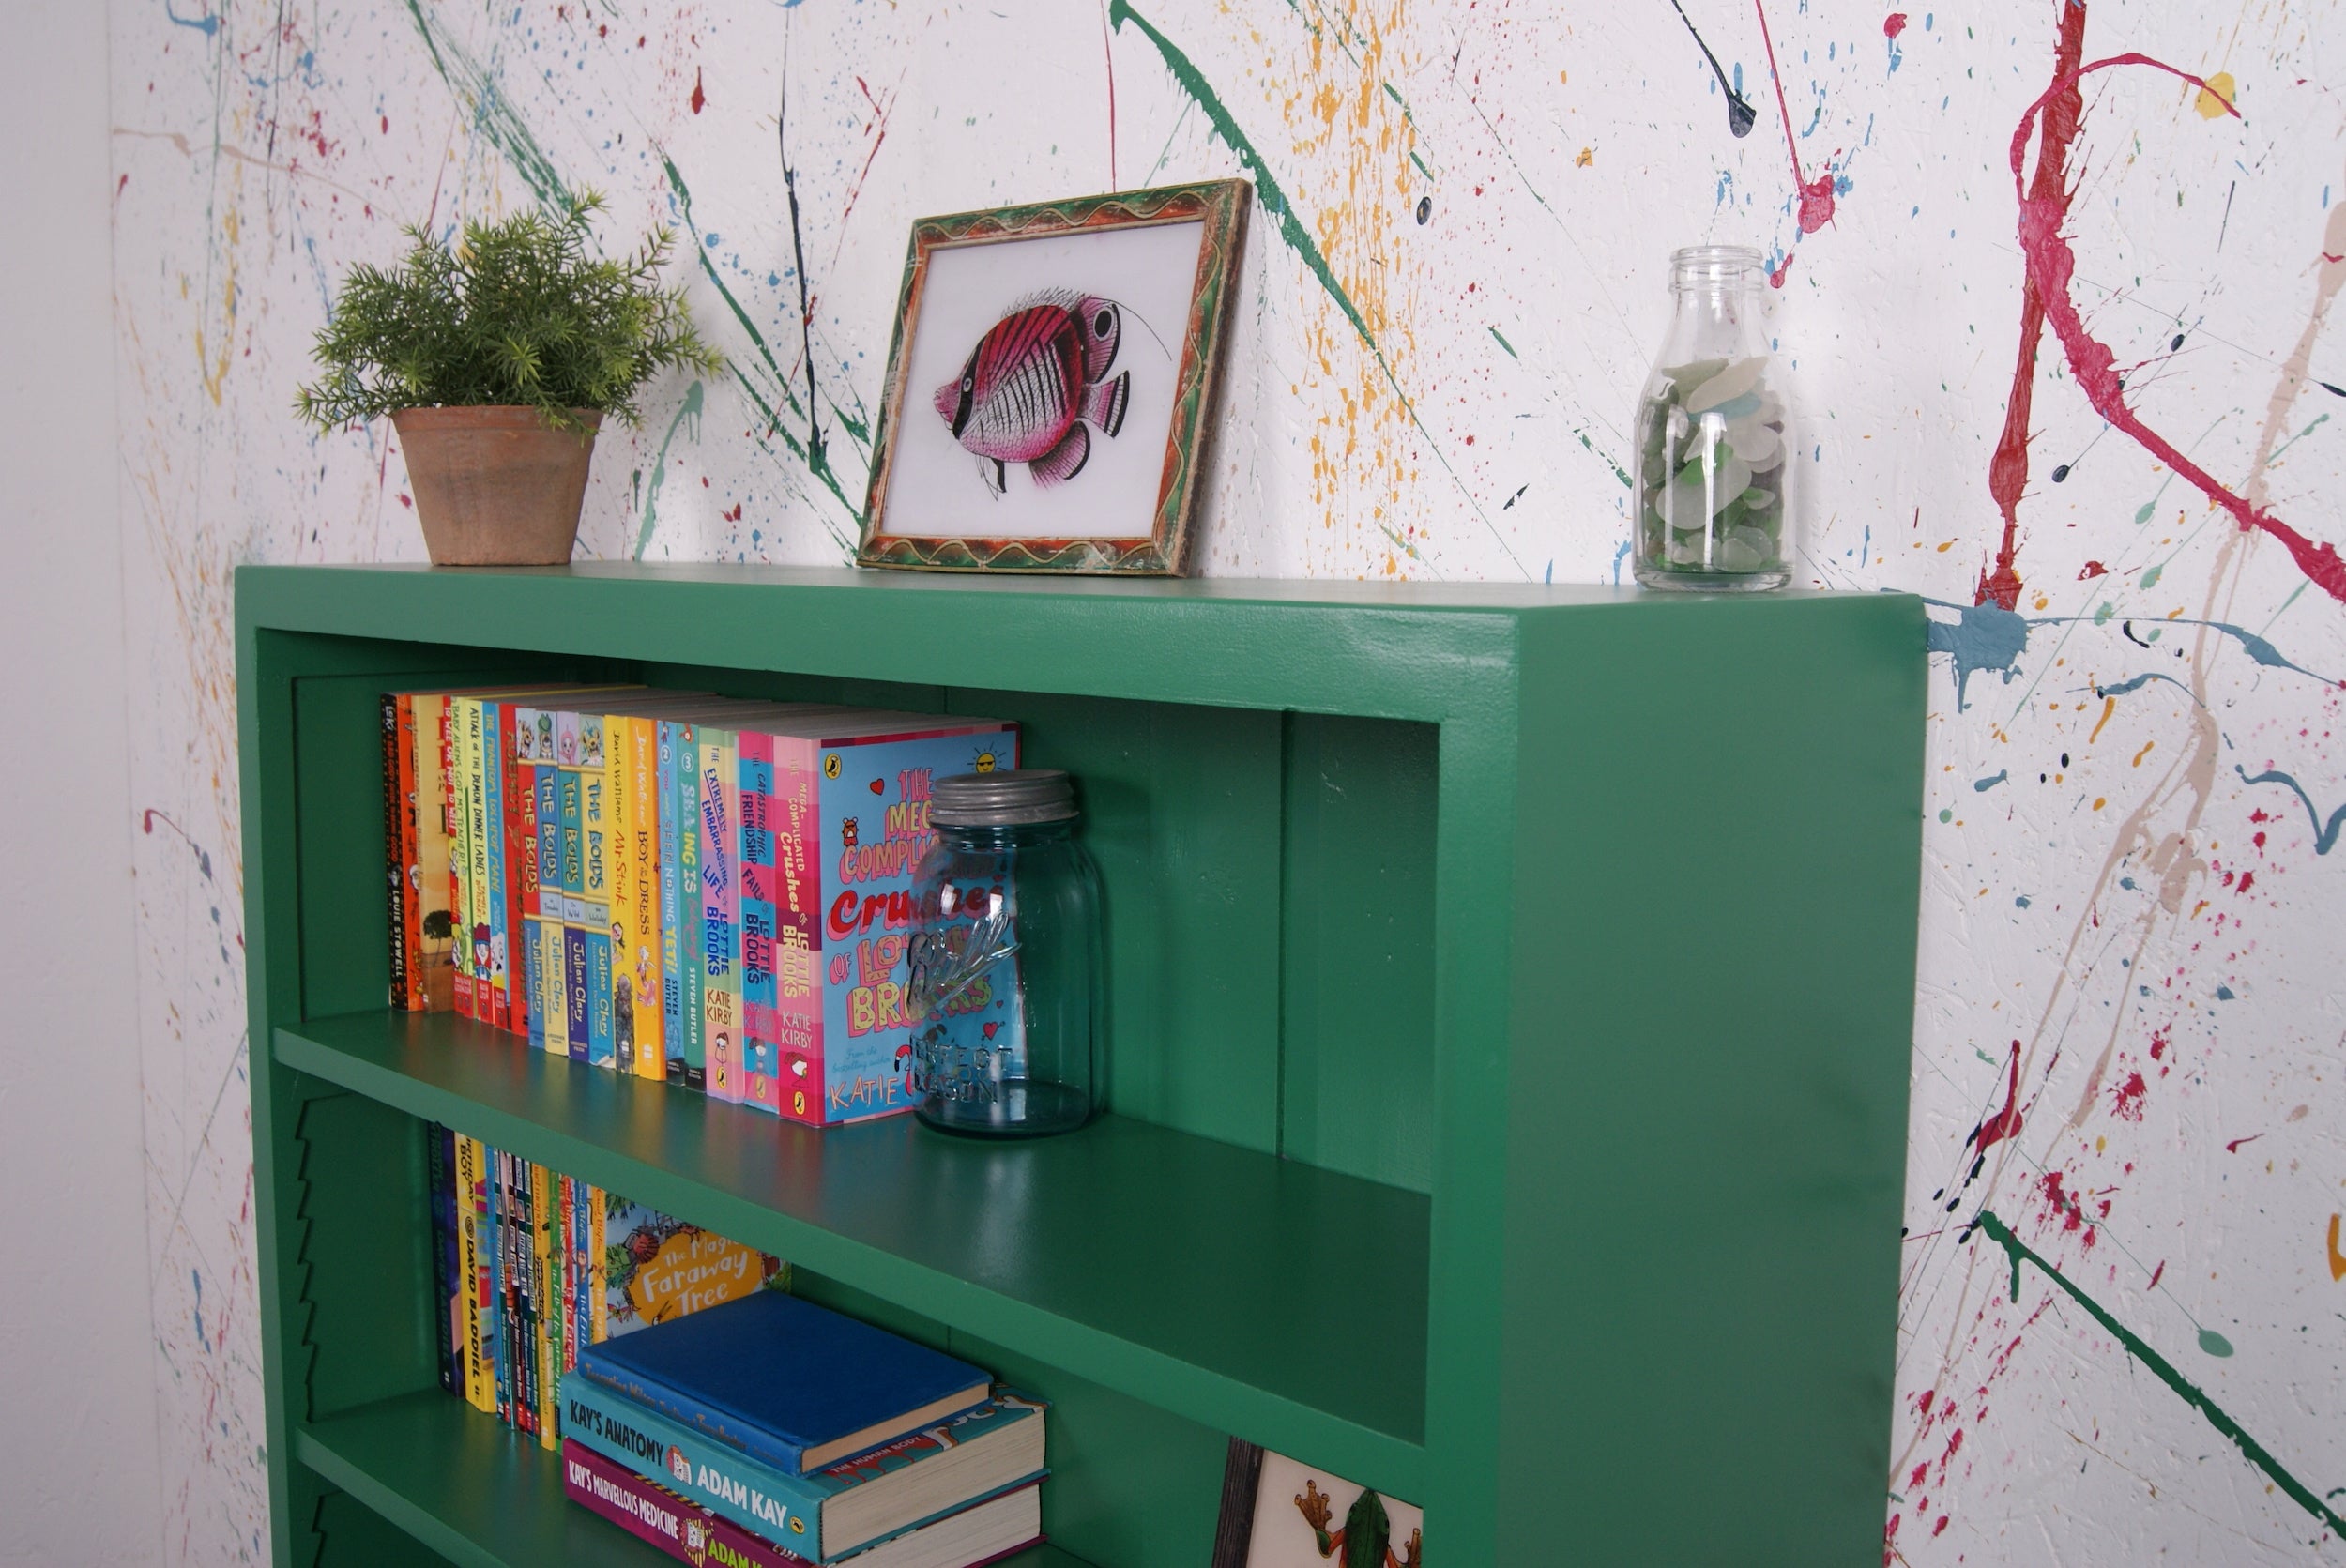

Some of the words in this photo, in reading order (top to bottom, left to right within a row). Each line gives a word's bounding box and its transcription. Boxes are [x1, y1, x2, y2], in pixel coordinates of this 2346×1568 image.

[470, 707, 480, 739] ATTACK
[453, 733, 462, 767] ALIENS
[613, 730, 621, 765] David
[472, 773, 482, 806] DEMON
[541, 773, 555, 814] THE
[563, 777, 576, 818] THE
[587, 778, 602, 823] THE
[707, 768, 727, 832] EXTREMELY
[899, 768, 934, 799] THE
[456, 798, 464, 813] MY
[473, 808, 483, 841] DINNER
[523, 784, 535, 826] THE
[756, 772, 767, 858] CATASTROPHIC
[886, 801, 935, 837] MEG
[615, 829, 625, 859] Mr
[638, 830, 648, 868] BOY
[665, 821, 674, 864] SEEN
[701, 799, 728, 887] EMBARRASSING
[742, 794, 758, 865] FRIENDSHIP
[788, 797, 805, 872] COMPLICATED
[475, 844, 486, 875] LADIES
[524, 834, 538, 893] BOLDS
[541, 821, 557, 879] BOLDS
[564, 827, 579, 884] BOLDS
[588, 830, 603, 891] BOLDS
[616, 862, 628, 907] Stink
[683, 869, 697, 893] IS
[703, 864, 724, 899] LIFE
[742, 868, 765, 901] FAILS
[780, 831, 800, 913] Crushes
[392, 890, 402, 922] LOUIE
[639, 879, 650, 936] DRESS
[664, 867, 676, 922] NOTHING
[394, 926, 404, 977] STOWELL
[532, 939, 542, 978] Julian
[552, 936, 562, 976] Julian
[665, 926, 678, 974] YETI!
[706, 906, 720, 976] BROOKS
[719, 912, 730, 975] LOTTIE
[746, 913, 760, 985] BROOKS
[759, 921, 770, 983] LOTTIE
[573, 942, 586, 983] Julian
[599, 945, 608, 991] Julian
[783, 924, 798, 999] BROOKS
[798, 931, 810, 997] LOTTIE
[831, 953, 851, 982] OF
[534, 981, 544, 1012] Clary
[553, 980, 563, 1013] Clary
[574, 987, 586, 1022] Clary
[689, 967, 697, 1005] STEVEN
[706, 988, 731, 1009] KATIE
[600, 998, 609, 1037] Clary
[690, 1006, 698, 1045] BUTLER
[706, 1005, 732, 1027] KIRBY
[783, 1012, 811, 1032] KATIE
[781, 1028, 813, 1050] KIRBY
[830, 1074, 899, 1111] KATIE
[460, 1144, 469, 1180] BOY
[466, 1137, 475, 1206] IRTHDAY
[577, 1210, 586, 1243] Blyton
[595, 1219, 604, 1251] Blyton
[466, 1239, 477, 1290] DAVID
[642, 1251, 749, 1303] Faraway
[664, 1251, 686, 1267] The
[676, 1283, 729, 1316] Tree
[469, 1298, 480, 1378] BADDIEL
[571, 1399, 602, 1436] KAY'S
[604, 1417, 664, 1467] ANATOMY
[830, 1462, 852, 1474] THE
[852, 1449, 891, 1466] HUMAN
[893, 1436, 922, 1453] BODY
[569, 1459, 593, 1493] KAY'S
[593, 1474, 639, 1516] MARVELLOUS
[638, 1497, 679, 1540] MEDICINE
[696, 1465, 748, 1511] ADAM
[751, 1489, 788, 1529] KAY
[708, 1538, 750, 1568] ADAM
